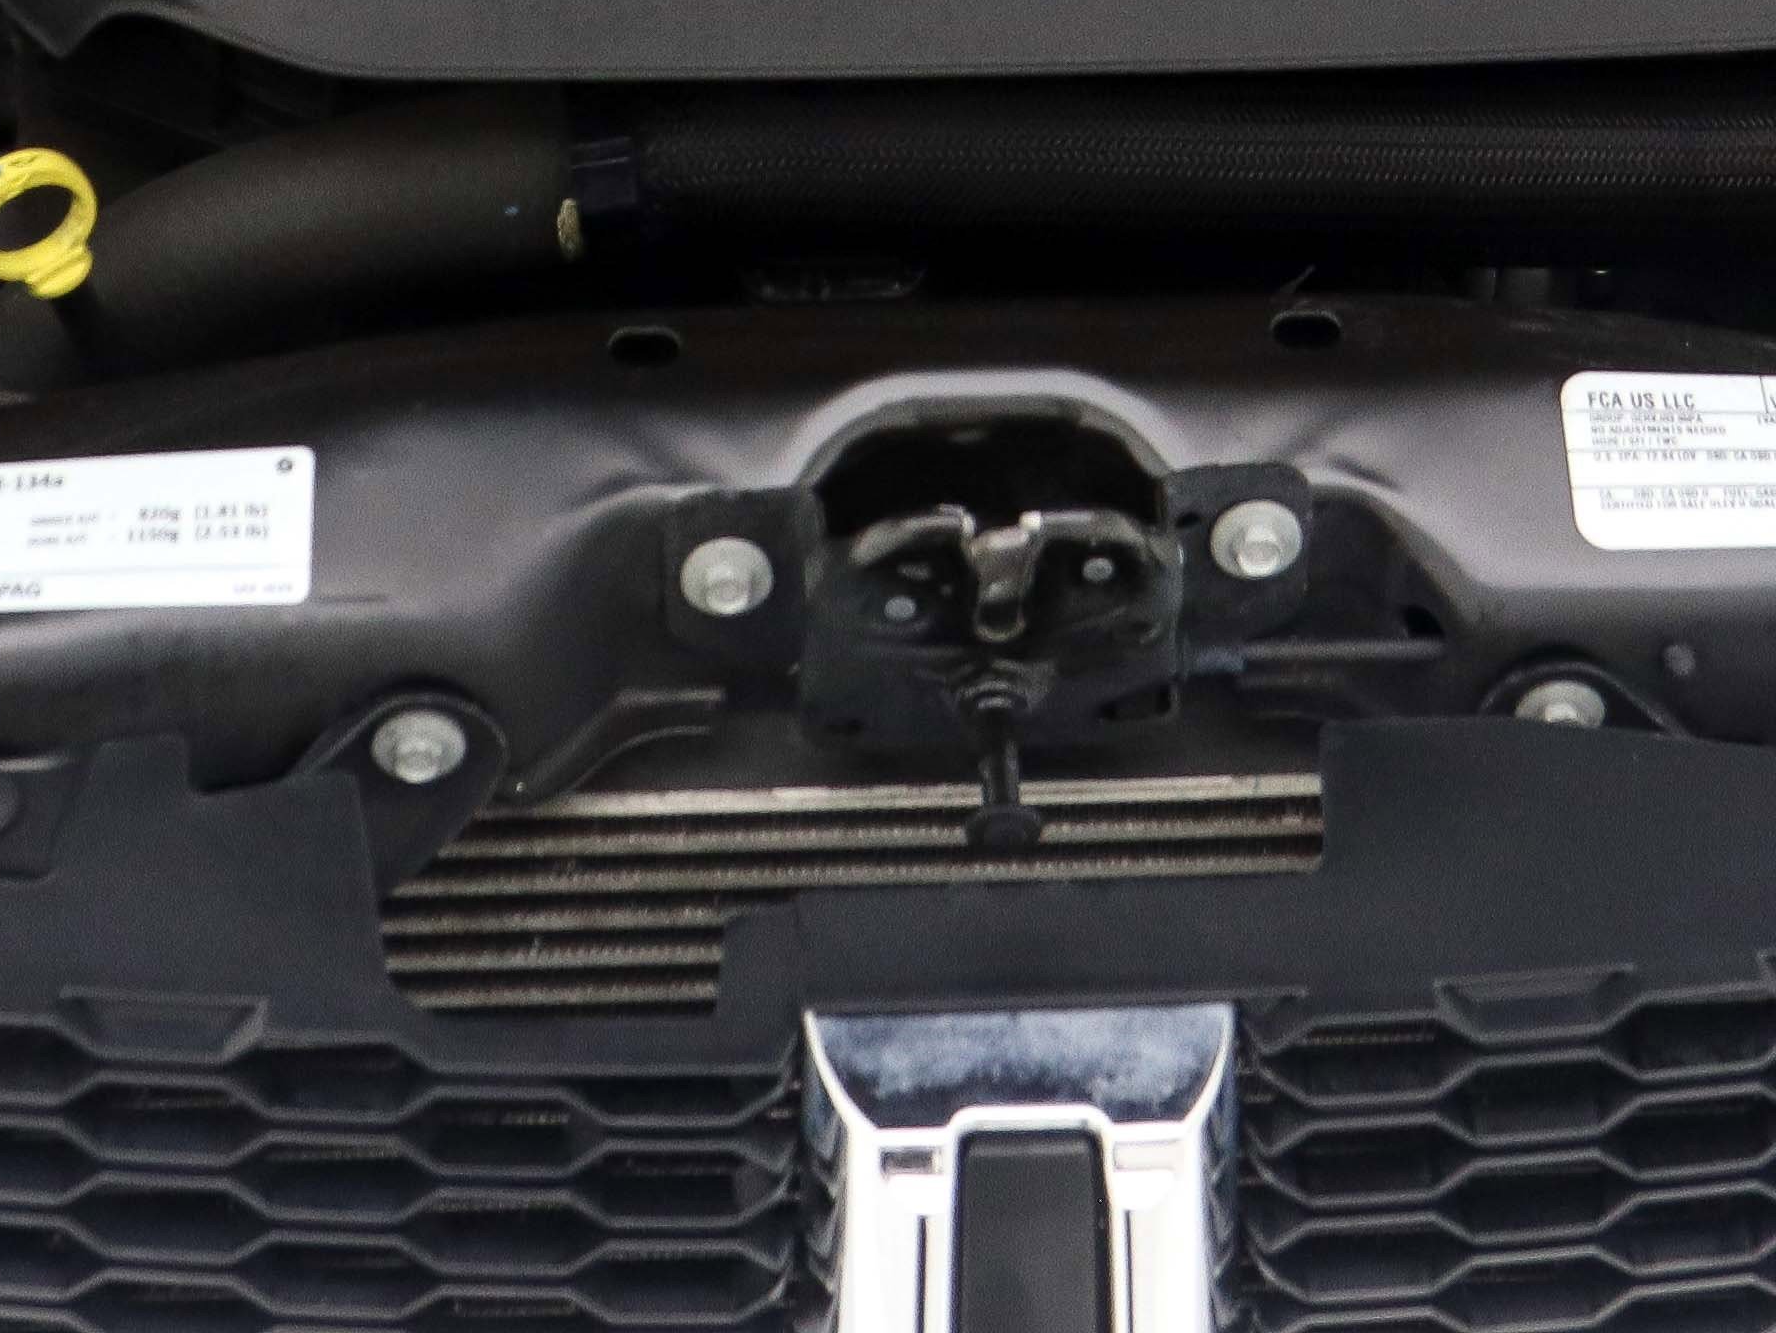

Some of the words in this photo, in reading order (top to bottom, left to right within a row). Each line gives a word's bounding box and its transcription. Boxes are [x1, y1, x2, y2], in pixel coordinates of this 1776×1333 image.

[1587, 391, 1622, 410] FCA
[1629, 392, 1655, 410] US
[1662, 392, 1696, 410] LLC
